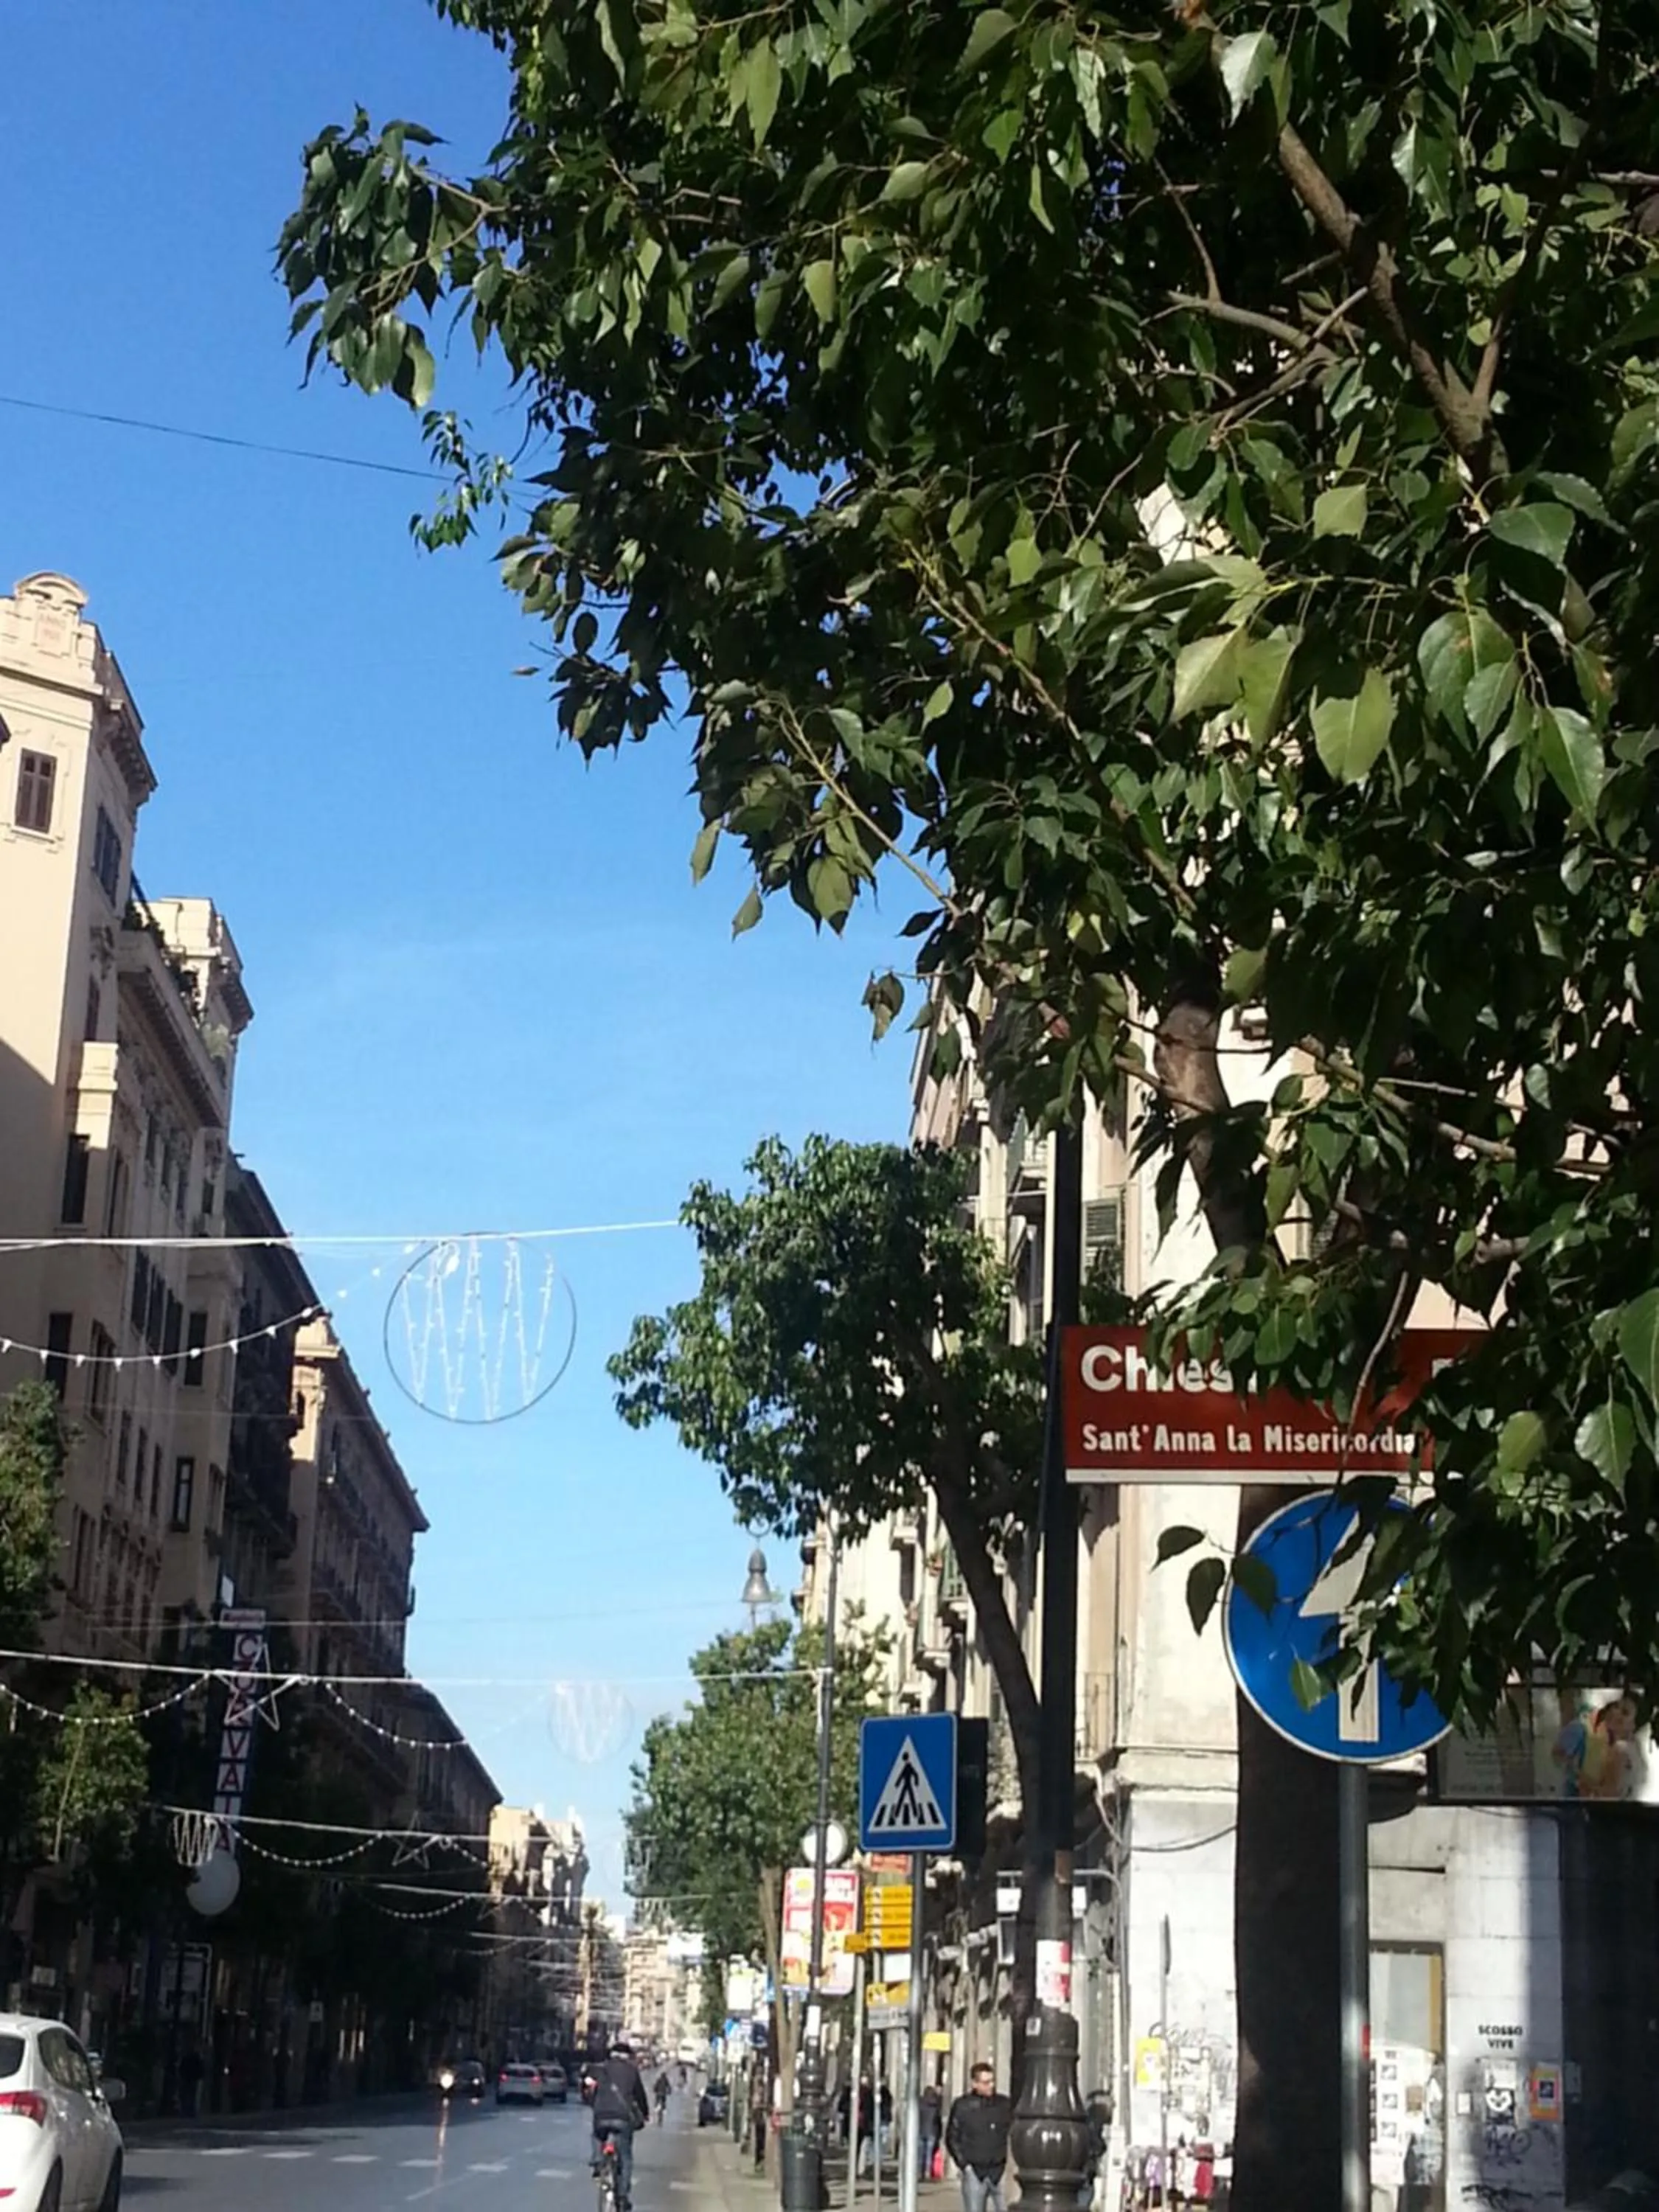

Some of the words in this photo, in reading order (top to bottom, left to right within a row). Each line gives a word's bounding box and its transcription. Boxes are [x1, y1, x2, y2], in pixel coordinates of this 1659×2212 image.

[1080, 1345, 1258, 1393] Ches
[1082, 1424, 1216, 1453] Sant'Anna
[1227, 1425, 1252, 1453] la
[1487, 2039, 1514, 2050] VIVE
